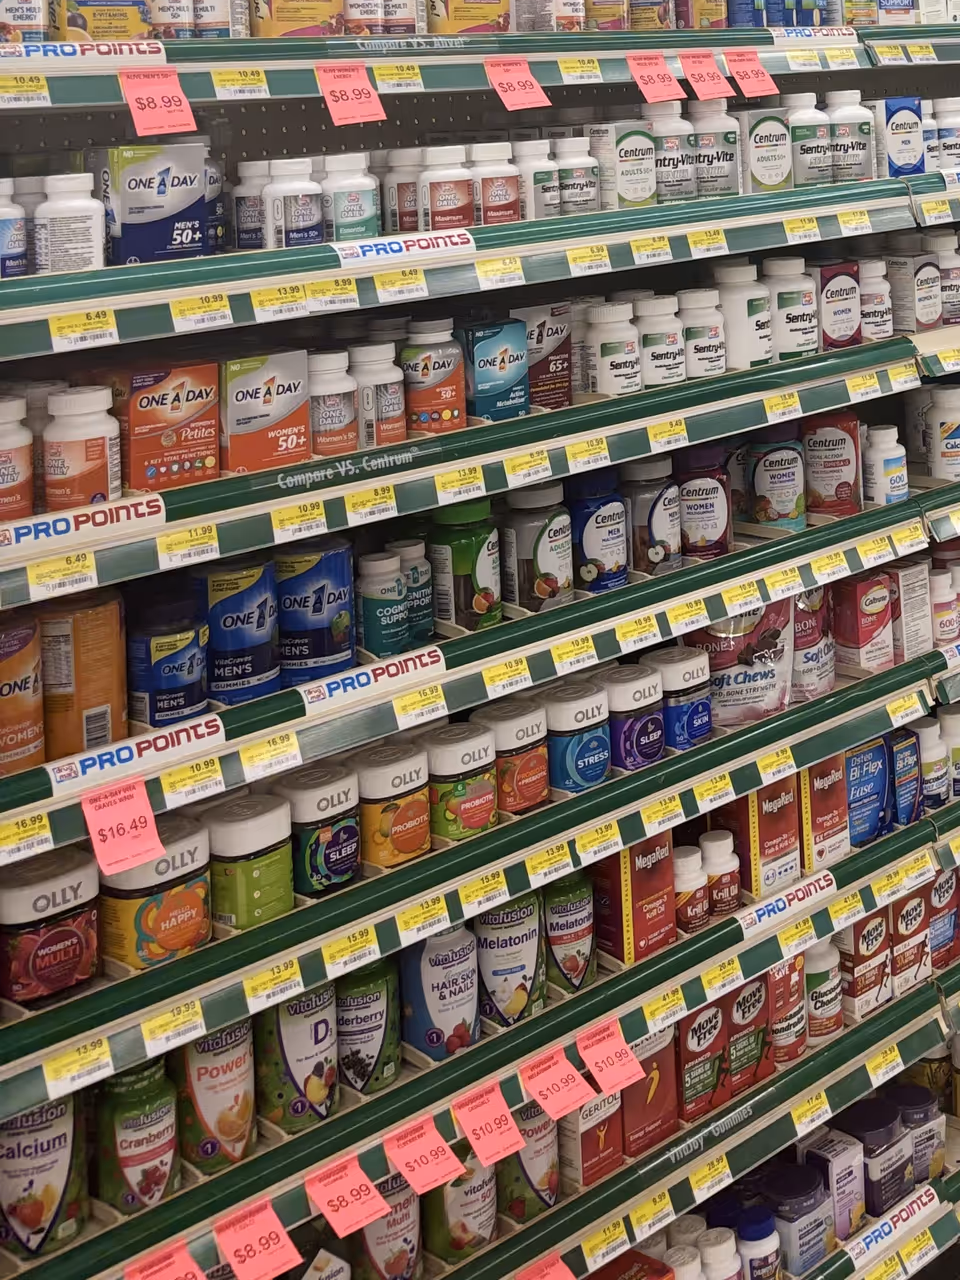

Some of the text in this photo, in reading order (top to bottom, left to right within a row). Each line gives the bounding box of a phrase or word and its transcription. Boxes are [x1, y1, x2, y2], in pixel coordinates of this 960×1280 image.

[14, 76, 41, 84] 10.49
[238, 70, 260, 78] 10.49
[639, 72, 672, 86] $8.99
[690, 72, 721, 83] $8.99
[735, 69, 766, 81] $8.99
[497, 80, 534, 93] $8.99
[329, 87, 372, 103] $8.99
[135, 95, 183, 112] $8.99
[619, 146, 653, 158] Centrum
[174, 220, 199, 230] MEN'S
[171, 229, 202, 245] 50+
[277, 285, 300, 296] 13.99
[334, 279, 352, 287] 8.99
[199, 294, 224, 304] 10.99
[825, 285, 857, 299] Centrum
[85, 311, 107, 320] 6.49
[549, 360, 569, 372] 65+
[180, 426, 216, 440] Petites
[268, 425, 306, 439] WOMEN'S
[277, 435, 307, 452] 50+
[764, 456, 799, 468] Centrum
[276, 468, 334, 489] Compare
[335, 459, 360, 477] VS.
[457, 467, 477, 477] 13.99
[769, 472, 796, 480] WOMEN
[373, 486, 391, 497] 8.99
[680, 485, 719, 496] Centrum
[298, 501, 321, 514] 10.99
[686, 502, 715, 511] WOMEN
[187, 525, 213, 538] 11.99
[65, 554, 87, 565] 6.49
[571, 636, 590, 648] 10.99
[214, 664, 253, 677] MEN'S
[504, 658, 524, 669] 10.99
[733, 668, 776, 684] Chews
[214, 679, 251, 690] GUMMIES
[418, 686, 439, 698] 16.99
[157, 696, 186, 710] MEN'S
[267, 734, 290, 748] 16.99
[640, 730, 662, 745] SLEEP
[189, 759, 215, 774] 10.99
[577, 750, 609, 769] STRESS
[851, 751, 873, 767] Osteo
[813, 768, 844, 792] MegaRed
[850, 781, 874, 800] Ease
[460, 793, 495, 811] PROBIOTIC
[762, 788, 794, 815] MegaRed
[14, 814, 43, 829] 16.99
[97, 815, 148, 843] $16.49
[391, 812, 429, 834] PROBIOTIC
[594, 823, 613, 836] 13.99
[329, 844, 358, 862] SLEEP
[545, 845, 565, 857] 13.99
[635, 842, 670, 871] MegaRed
[480, 871, 501, 885] 15.99
[419, 896, 441, 910] 13.99
[161, 907, 198, 930] HAPPY
[480, 903, 535, 926] vitafusion
[550, 912, 593, 932] Melatonin
[346, 928, 370, 944] 15.99
[477, 927, 538, 950] Melatonin
[37, 937, 78, 956] WOMEN'S
[35, 948, 80, 969] MULTI
[271, 960, 295, 976] 13.99
[75, 1039, 103, 1056] 13.99
[594, 1048, 629, 1073] $10.99
[196, 1055, 247, 1082] Power
[538, 1073, 576, 1101] $10.99
[581, 1092, 620, 1121] GERITOL
[471, 1114, 509, 1141] $10.99
[119, 1123, 175, 1151] Cranberry
[404, 1145, 447, 1172] $10.99
[327, 1183, 371, 1213] $8.99
[602, 1220, 621, 1236] 11.99
[233, 1230, 281, 1264] $8.99
